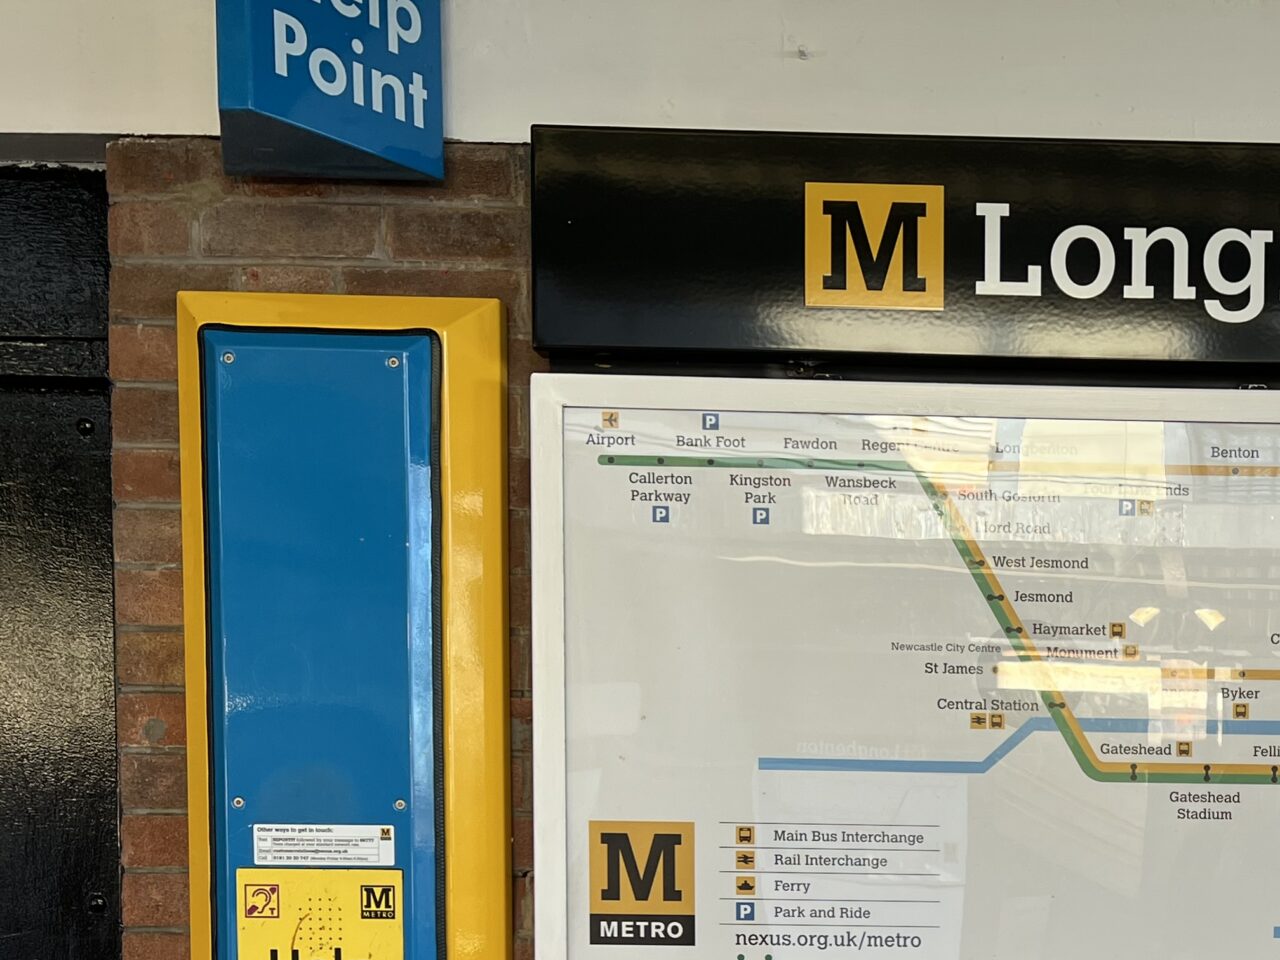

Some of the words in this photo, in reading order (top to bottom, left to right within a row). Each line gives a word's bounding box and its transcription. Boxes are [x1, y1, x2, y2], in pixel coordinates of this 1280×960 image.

[274, 9, 427, 128] Point
[822, 201, 926, 292] M
[586, 434, 636, 447] Airport
[676, 435, 711, 447] Bank
[716, 436, 746, 448] Foot
[783, 438, 838, 450] Fawdon
[1211, 447, 1259, 459] Benton
[629, 472, 692, 485] Callerton
[729, 474, 791, 488] Kingston
[825, 476, 896, 489] Wansbeck
[631, 490, 690, 504] Parkway
[744, 492, 776, 504] Park
[992, 556, 1026, 569] West
[1030, 556, 1089, 569] Jesmond
[1014, 591, 1073, 603] Jesmond
[1032, 623, 1106, 638] Haymarket
[891, 642, 942, 652] Newcastle
[946, 643, 965, 654] City
[968, 644, 1001, 653] Centre
[1046, 647, 1118, 659] Monument
[925, 663, 939, 674] St
[942, 663, 983, 675] James
[1221, 688, 1259, 701] Byker
[937, 699, 987, 711] Central
[991, 700, 1039, 712] Station
[1100, 744, 1172, 756] Gateshead
[1169, 791, 1240, 804] Gateshead
[1177, 808, 1232, 820] Stadium
[774, 830, 808, 842] Main
[812, 831, 837, 842] Bus
[842, 832, 924, 845] Interchange
[774, 854, 801, 866] Rail
[805, 855, 887, 869] Interchange
[774, 880, 810, 894] Ferry
[774, 907, 805, 918] Park
[809, 907, 834, 918] and
[839, 907, 870, 919] Ride
[600, 922, 683, 938] METRO
[735, 930, 921, 950] nexus.org.uk/metro
